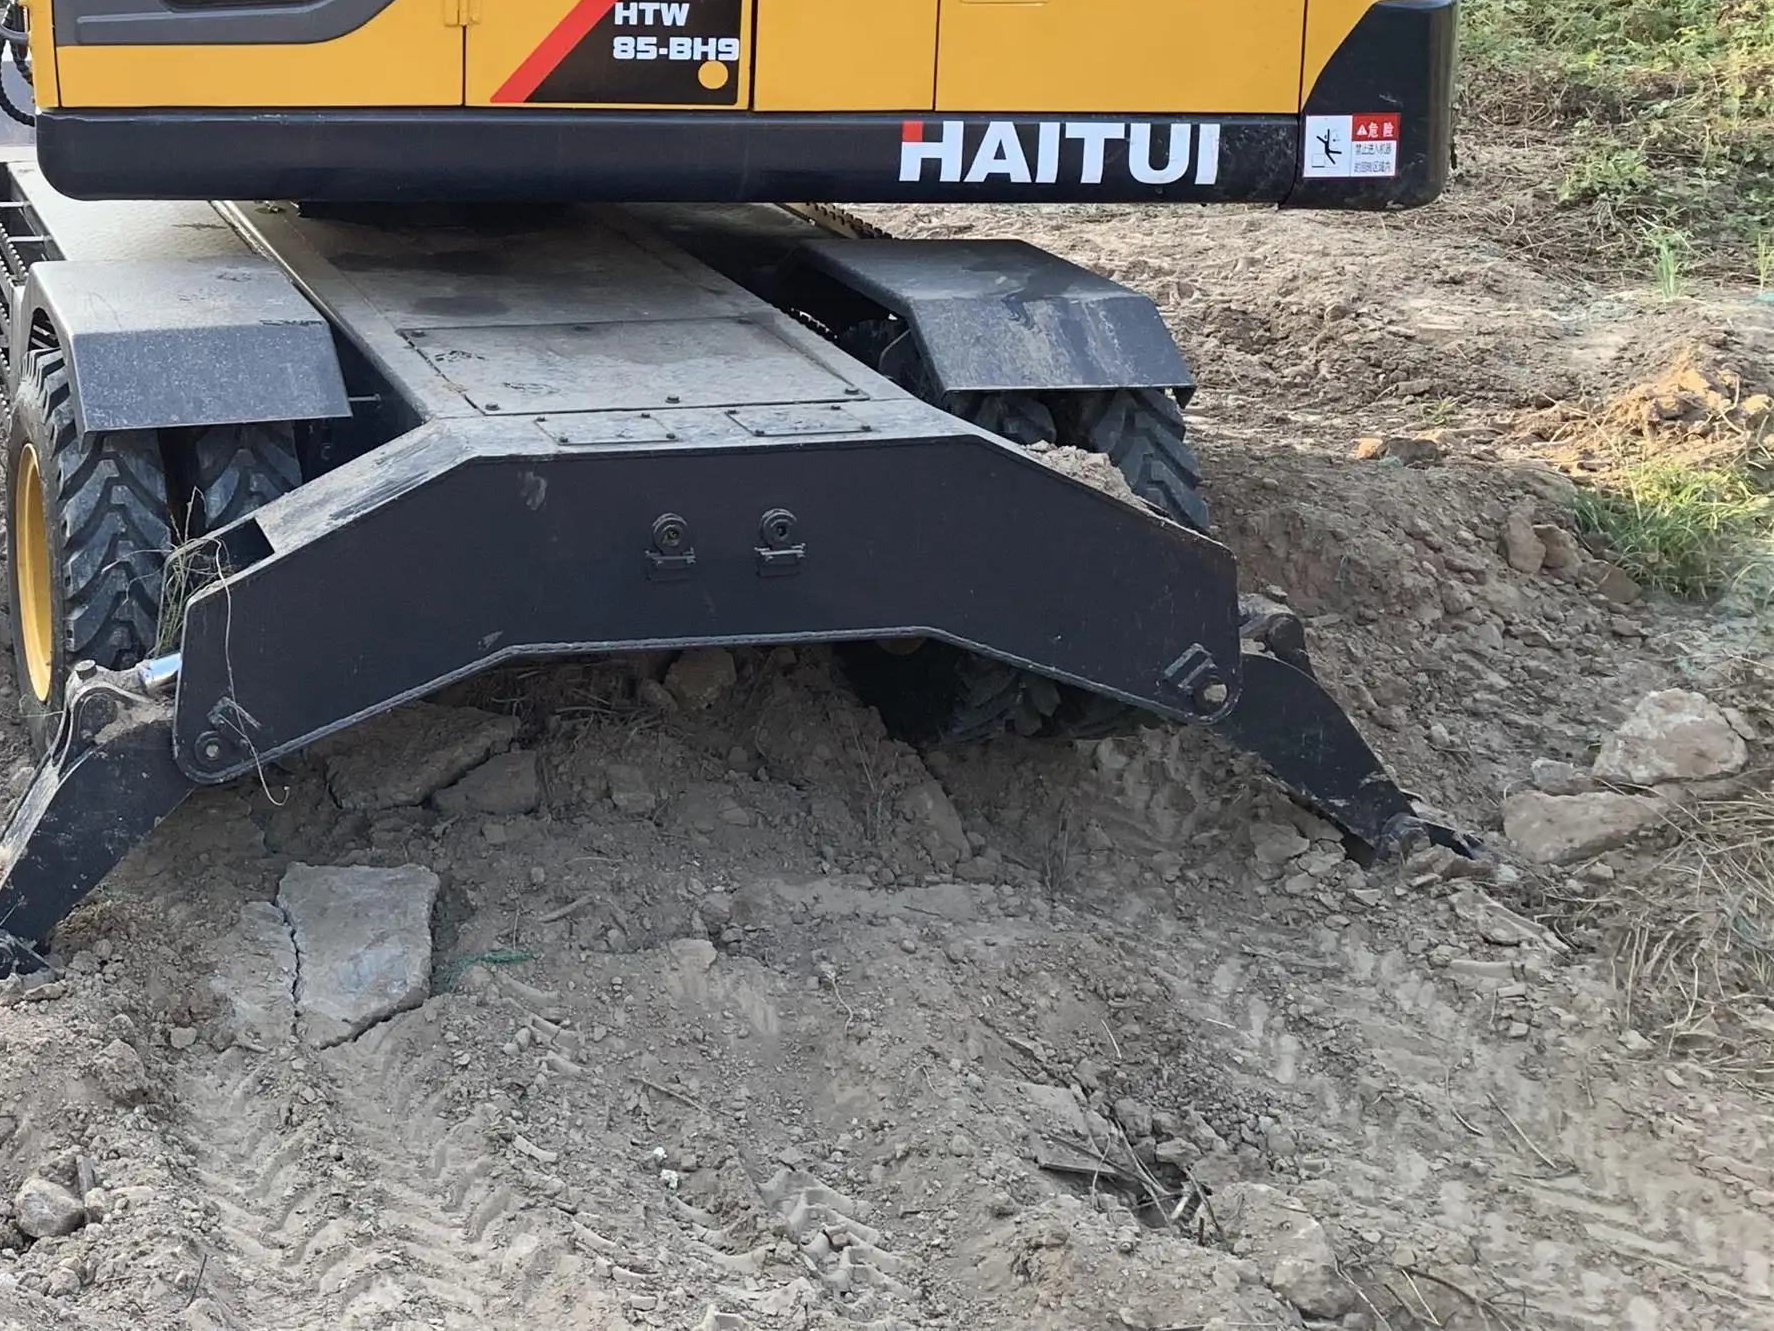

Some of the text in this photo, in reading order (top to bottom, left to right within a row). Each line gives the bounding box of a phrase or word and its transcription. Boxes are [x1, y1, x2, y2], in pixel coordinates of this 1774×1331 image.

[614, 2, 690, 26] HTW
[613, 36, 740, 61] 85-BH9
[899, 120, 1221, 185] HAITUI
